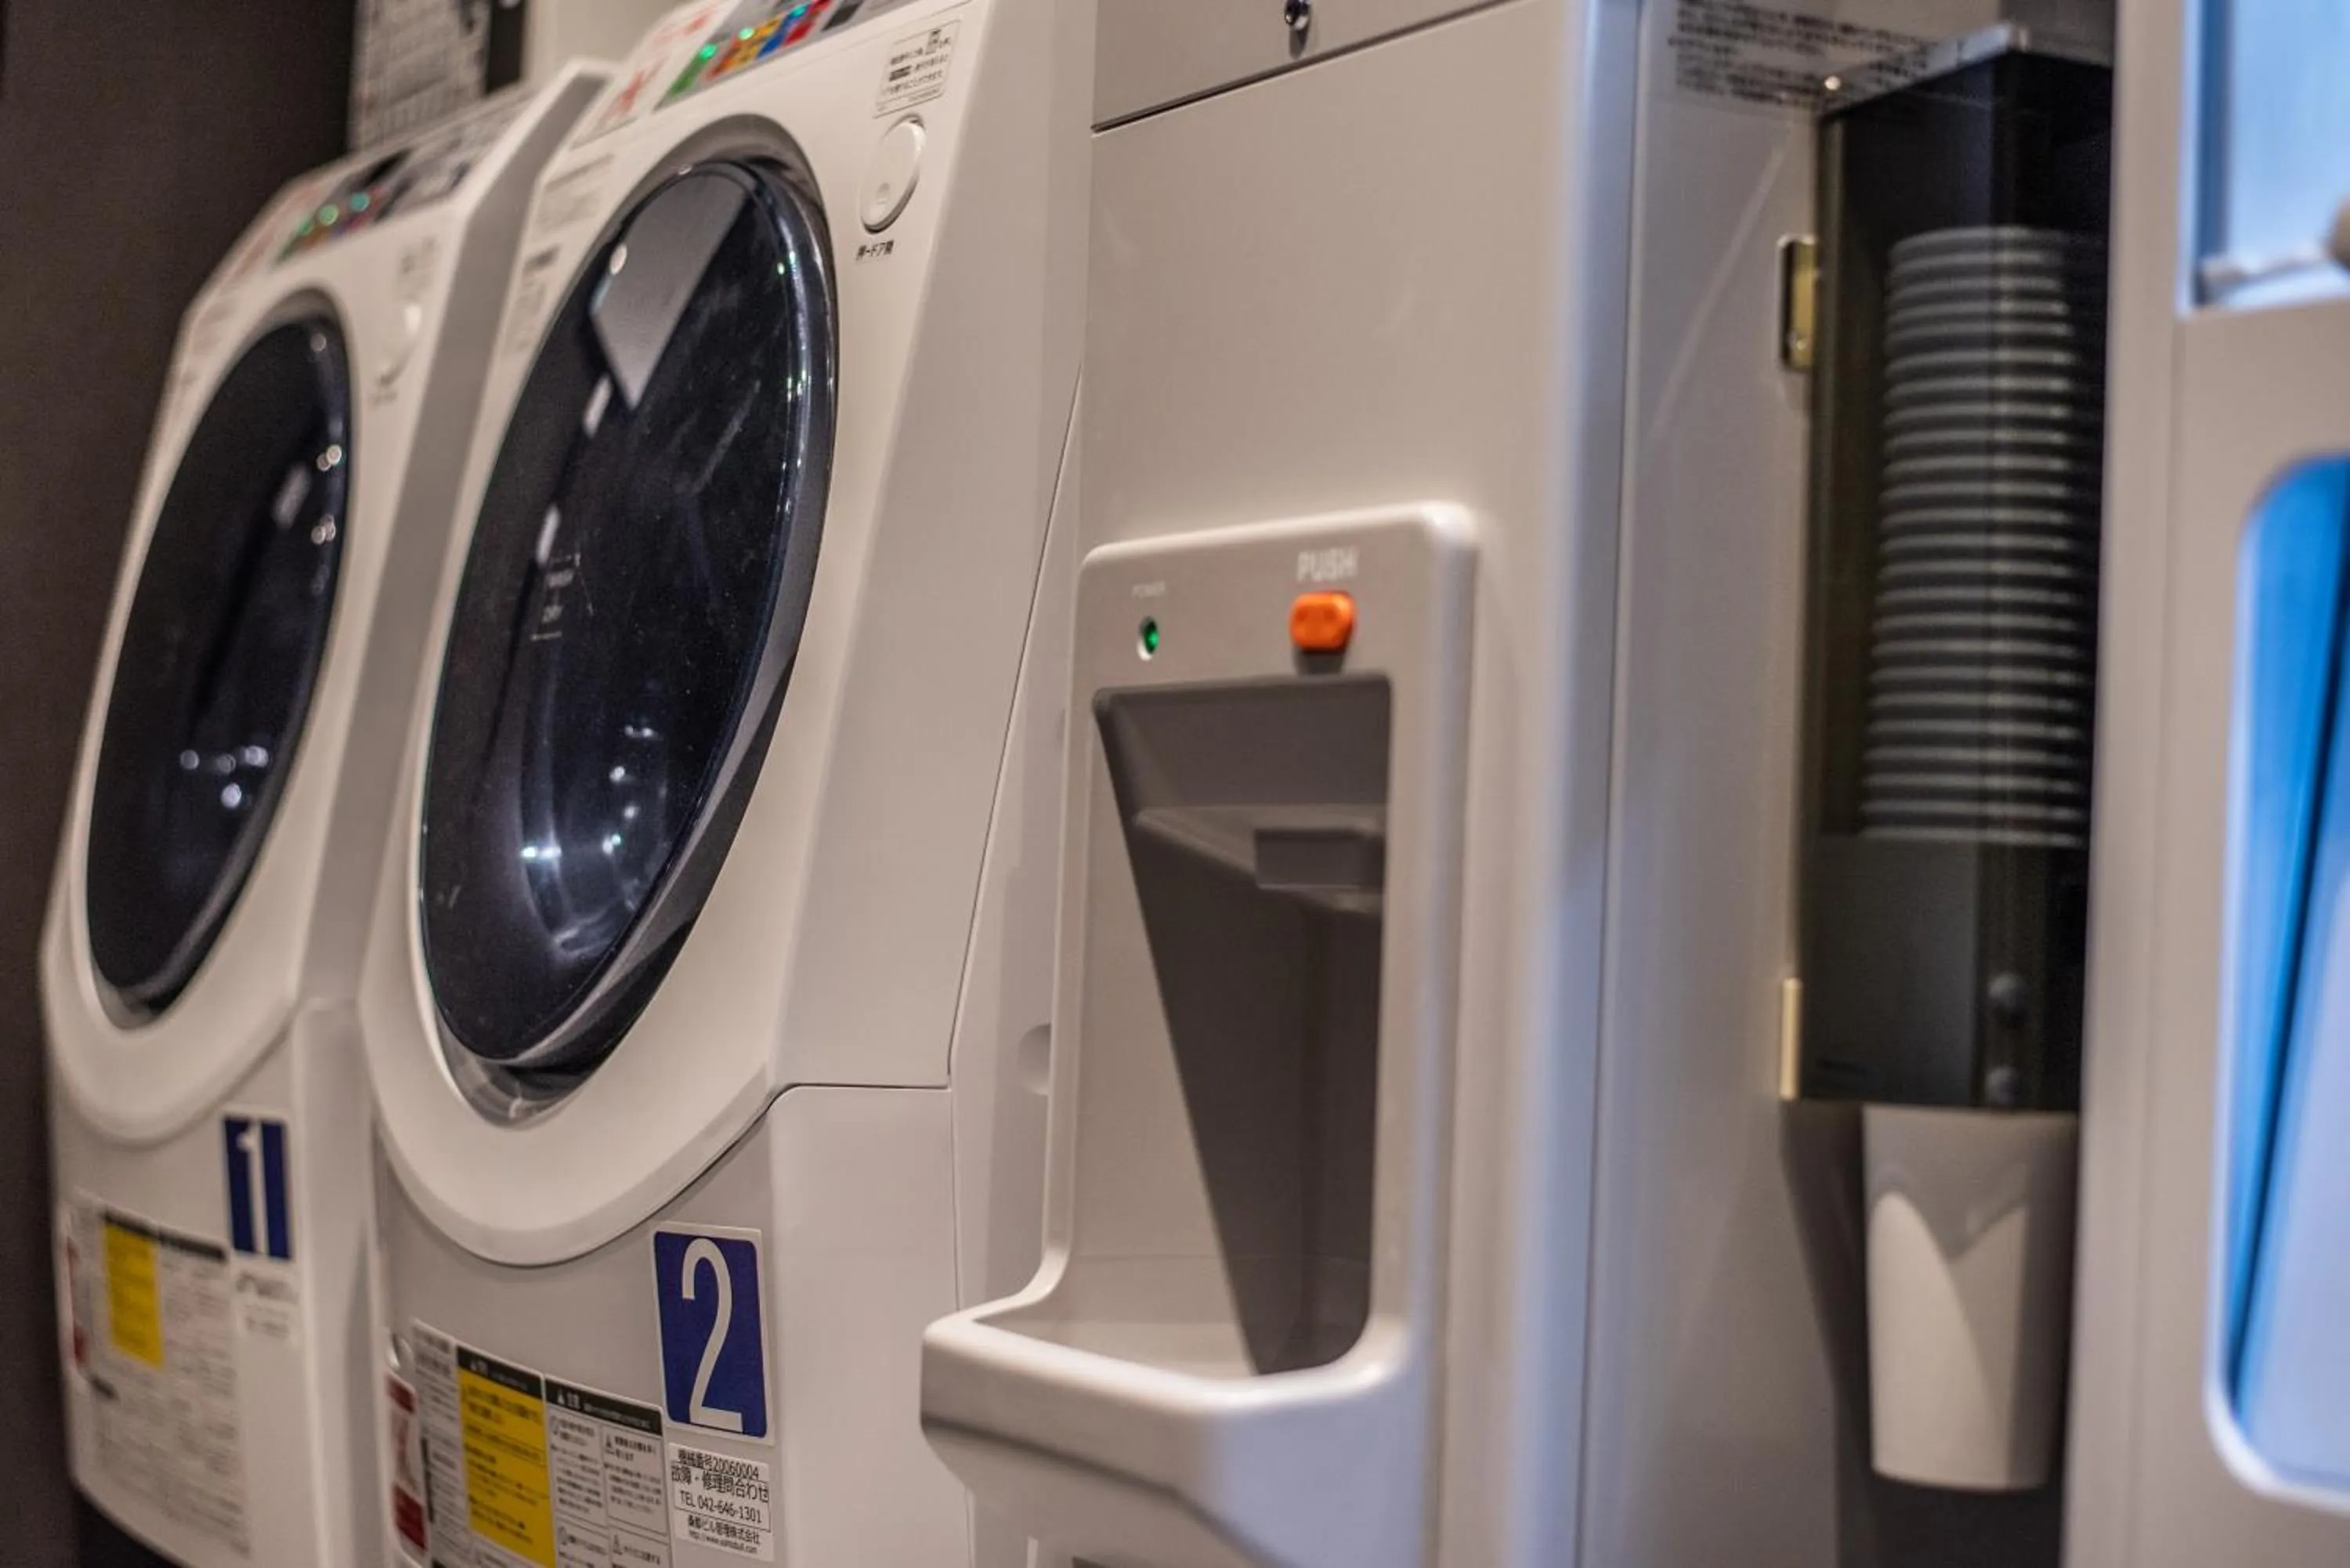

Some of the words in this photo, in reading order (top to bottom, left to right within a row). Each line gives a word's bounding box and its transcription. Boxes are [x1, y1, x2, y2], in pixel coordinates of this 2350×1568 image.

[1296, 547, 1358, 582] PUSH
[237, 1119, 268, 1255] 1
[681, 1238, 743, 1433] 2
[680, 1490, 696, 1508] TEL
[697, 1494, 762, 1523] 042-646-1301
